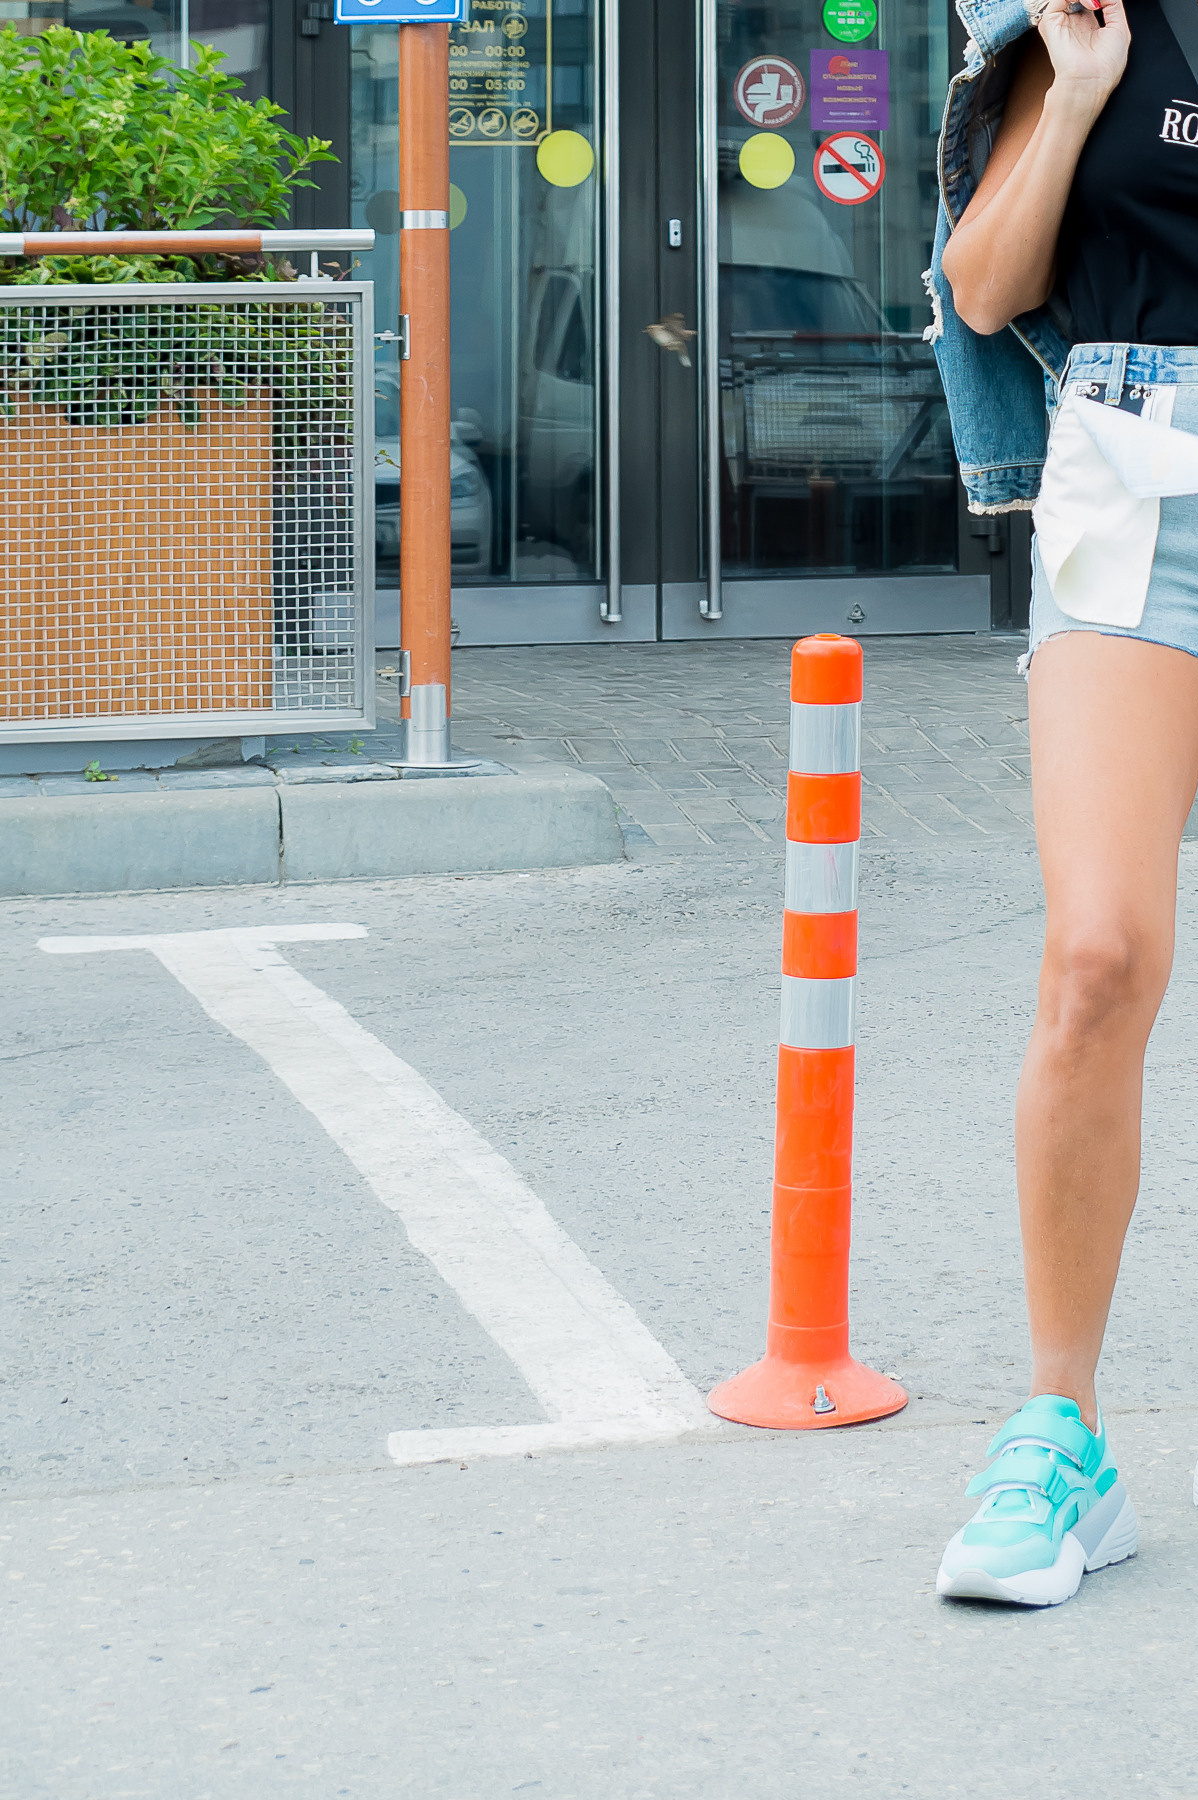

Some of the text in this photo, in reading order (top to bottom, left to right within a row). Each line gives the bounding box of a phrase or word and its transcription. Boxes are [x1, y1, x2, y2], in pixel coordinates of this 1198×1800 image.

[459, 20, 495, 34] ЗАЛ
[484, 45, 526, 58] 00:00
[484, 79, 526, 91] 05:00
